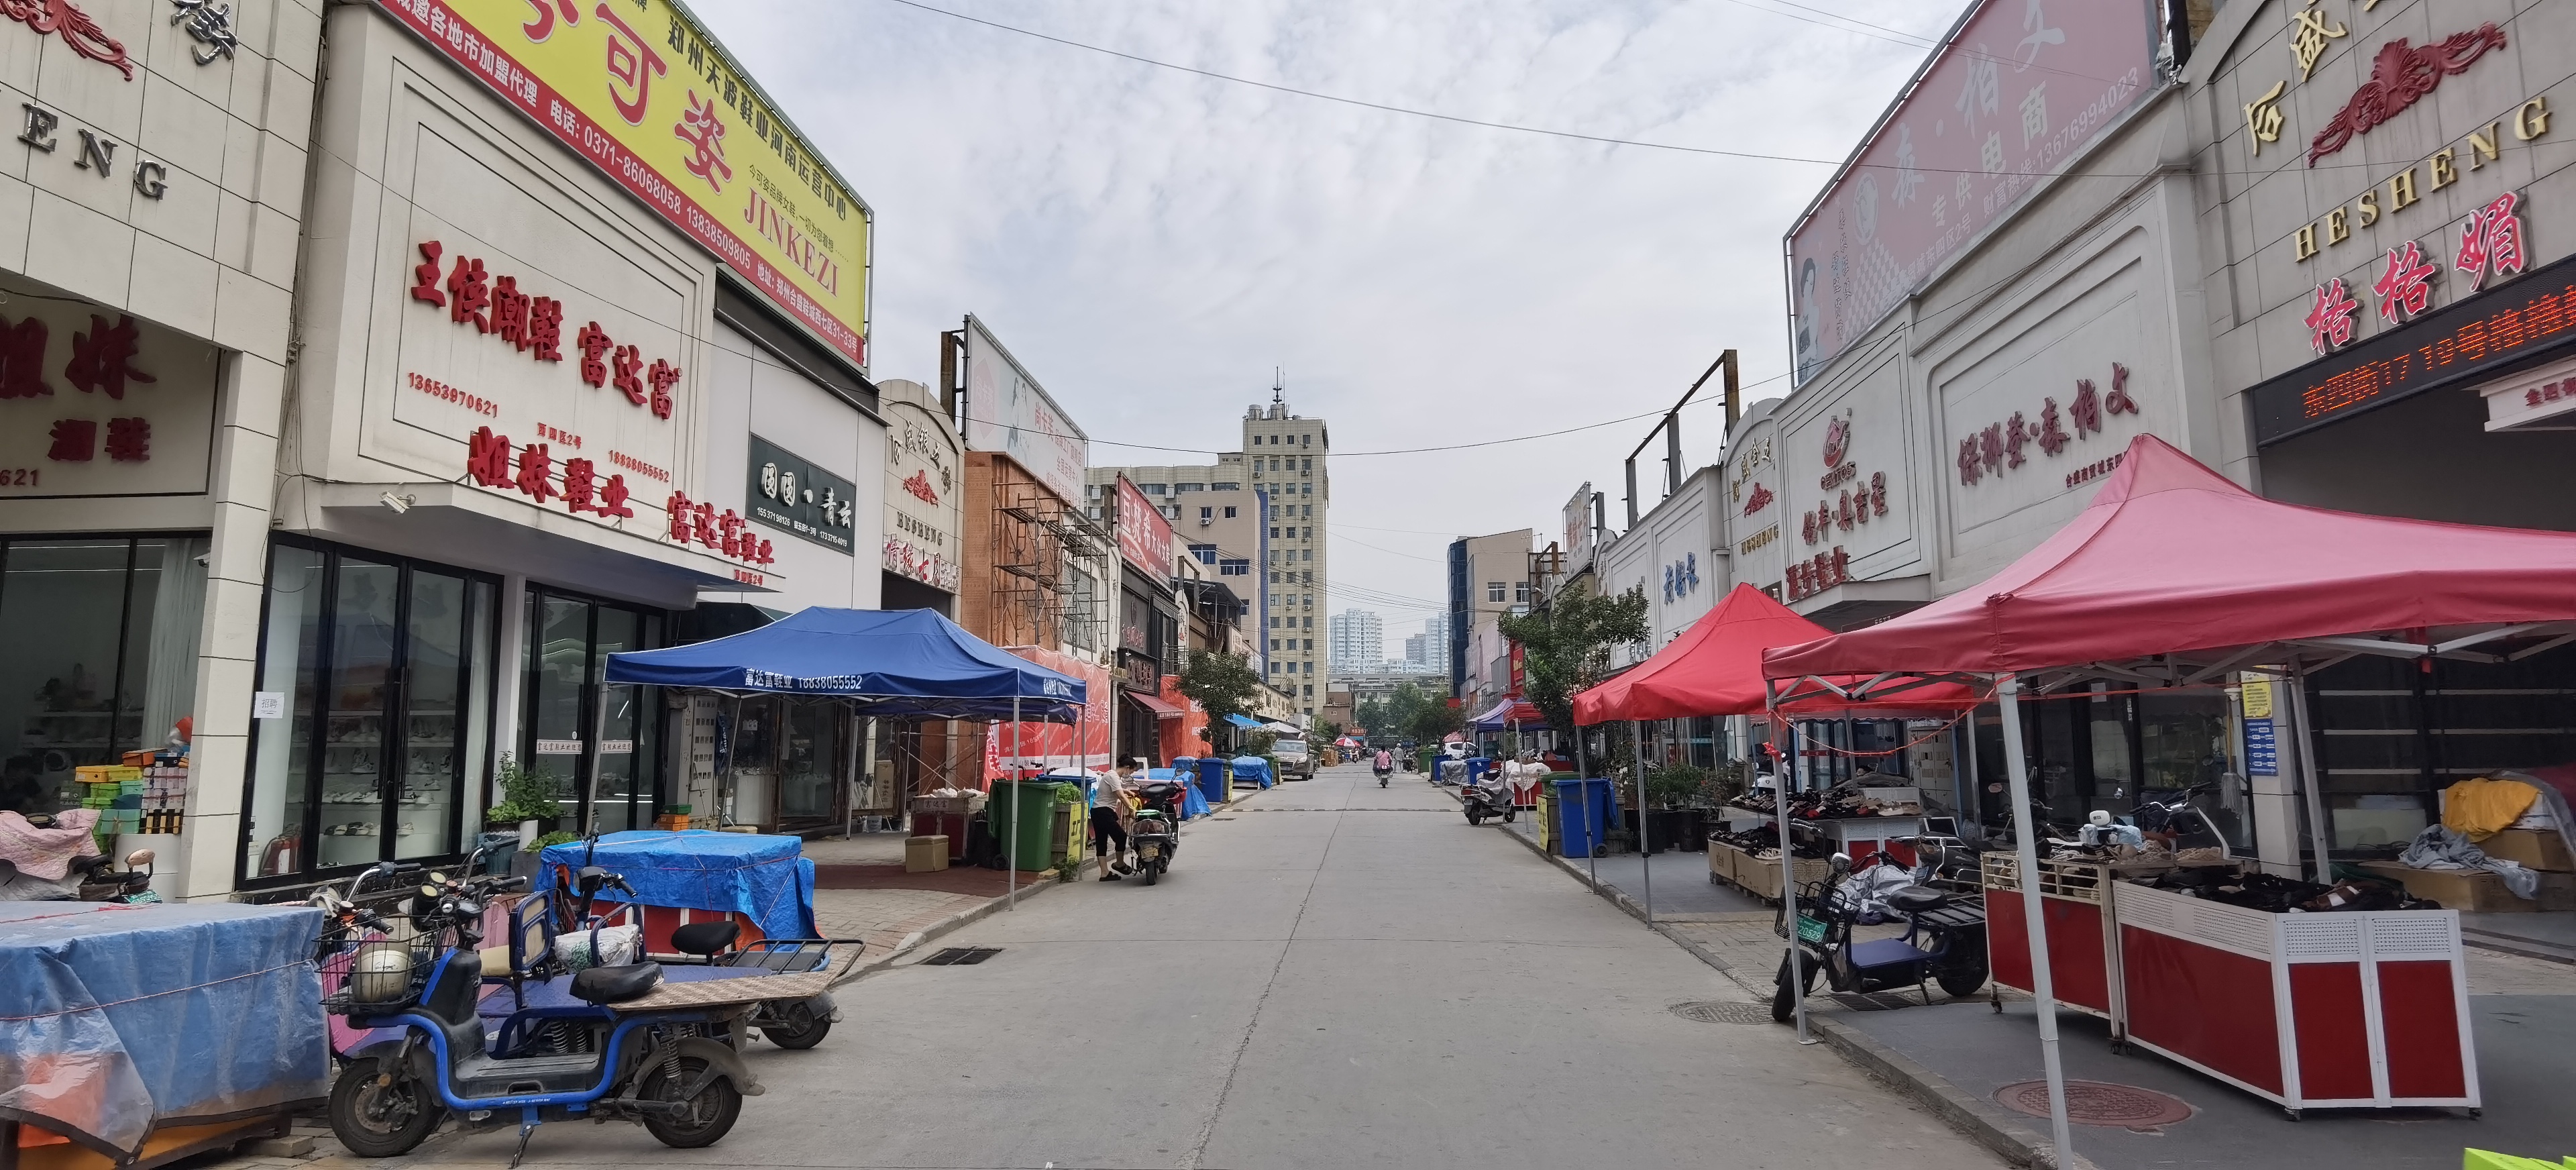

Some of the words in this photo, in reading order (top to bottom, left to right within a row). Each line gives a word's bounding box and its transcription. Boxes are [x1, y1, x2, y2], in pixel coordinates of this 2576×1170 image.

[17, 102, 168, 201] ENG
[2292, 95, 2551, 264] HESHENG
[686, 205, 751, 270] 13838509805
[743, 187, 841, 297] JINKEZI
[2302, 190, 2529, 356] 格格媚
[408, 372, 499, 419] 13653970621
[467, 425, 634, 519] 姐妹鞋业
[608, 449, 670, 484] 18838055552
[757, 506, 791, 527] 15537198126
[820, 530, 847, 547] 17337154019
[896, 511, 943, 546] HESHENG
[262, 698, 278, 709] 招聘
